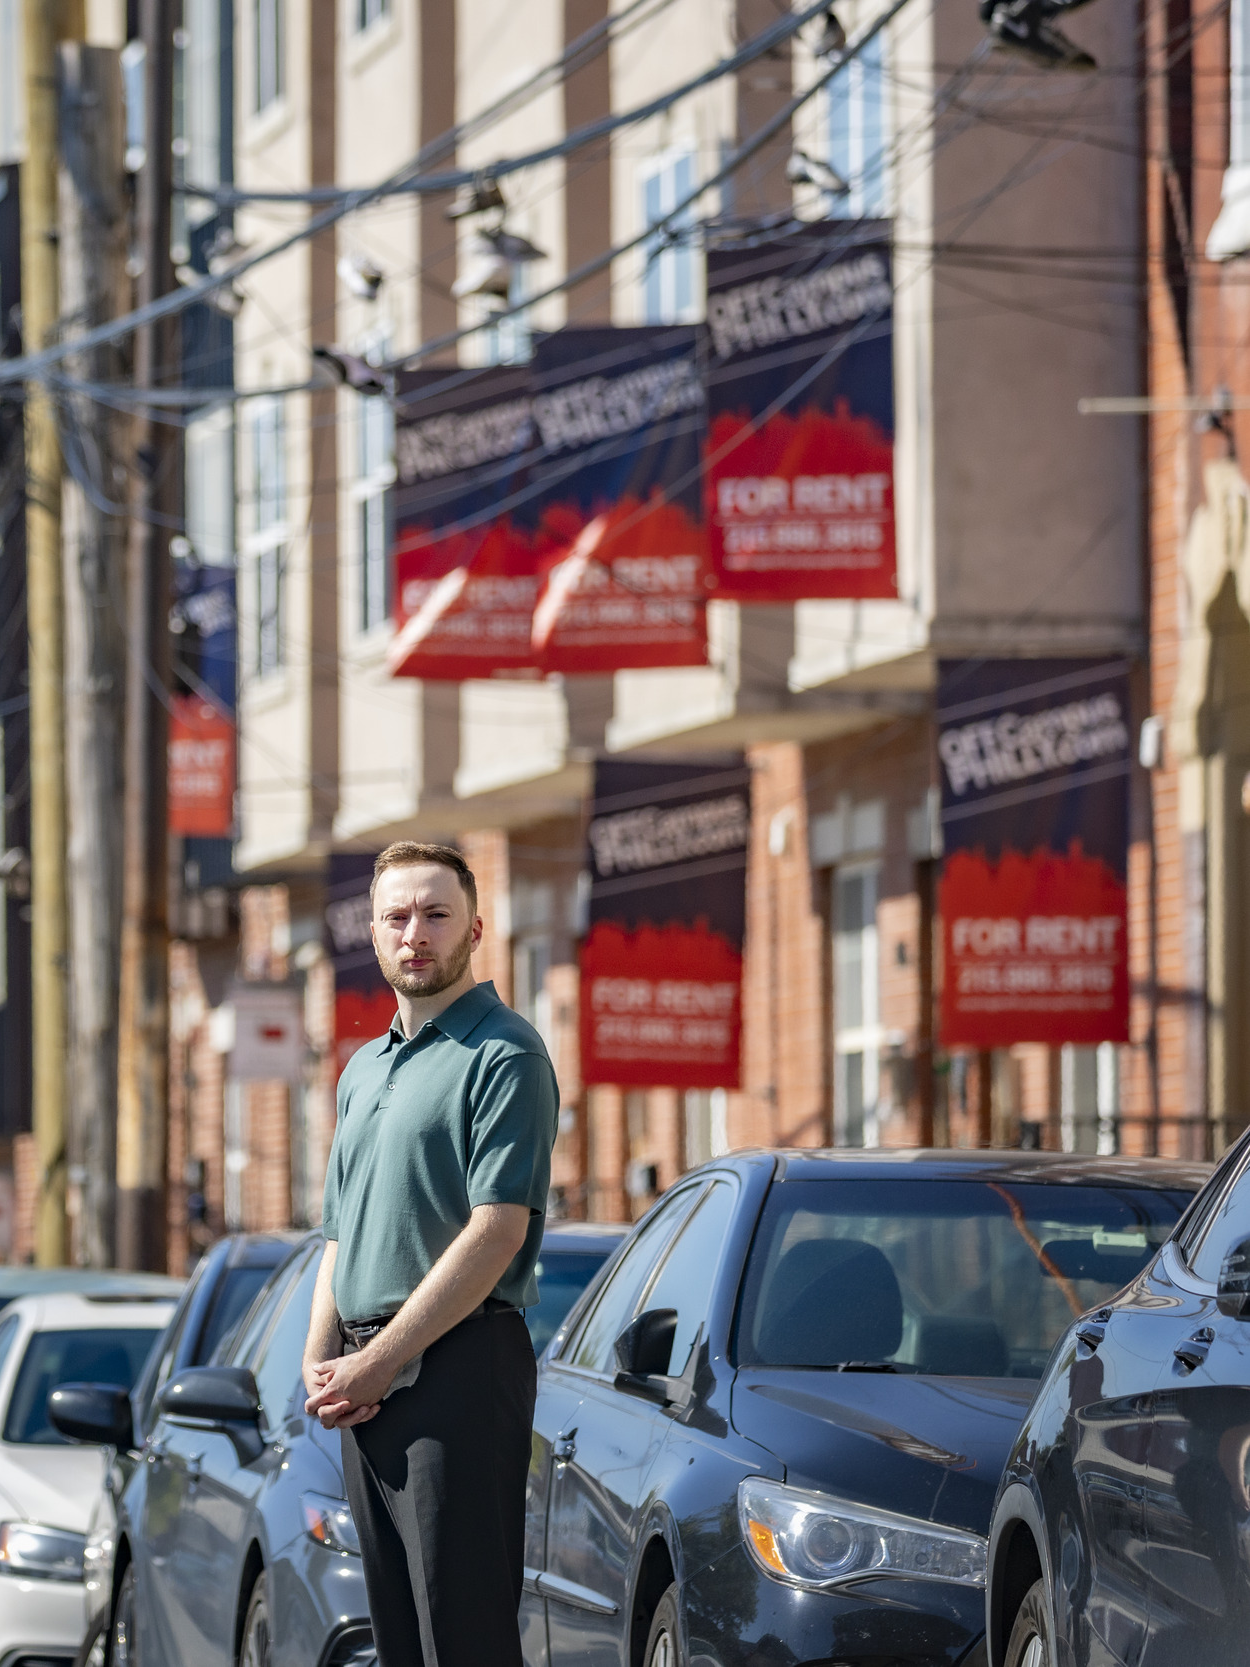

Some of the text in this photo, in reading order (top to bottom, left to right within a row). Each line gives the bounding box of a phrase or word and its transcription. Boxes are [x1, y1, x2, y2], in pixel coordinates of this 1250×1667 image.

[717, 472, 890, 517] FOR RENT
[953, 915, 1120, 956] FOR RENT
[592, 977, 736, 1018] FOR RENT
